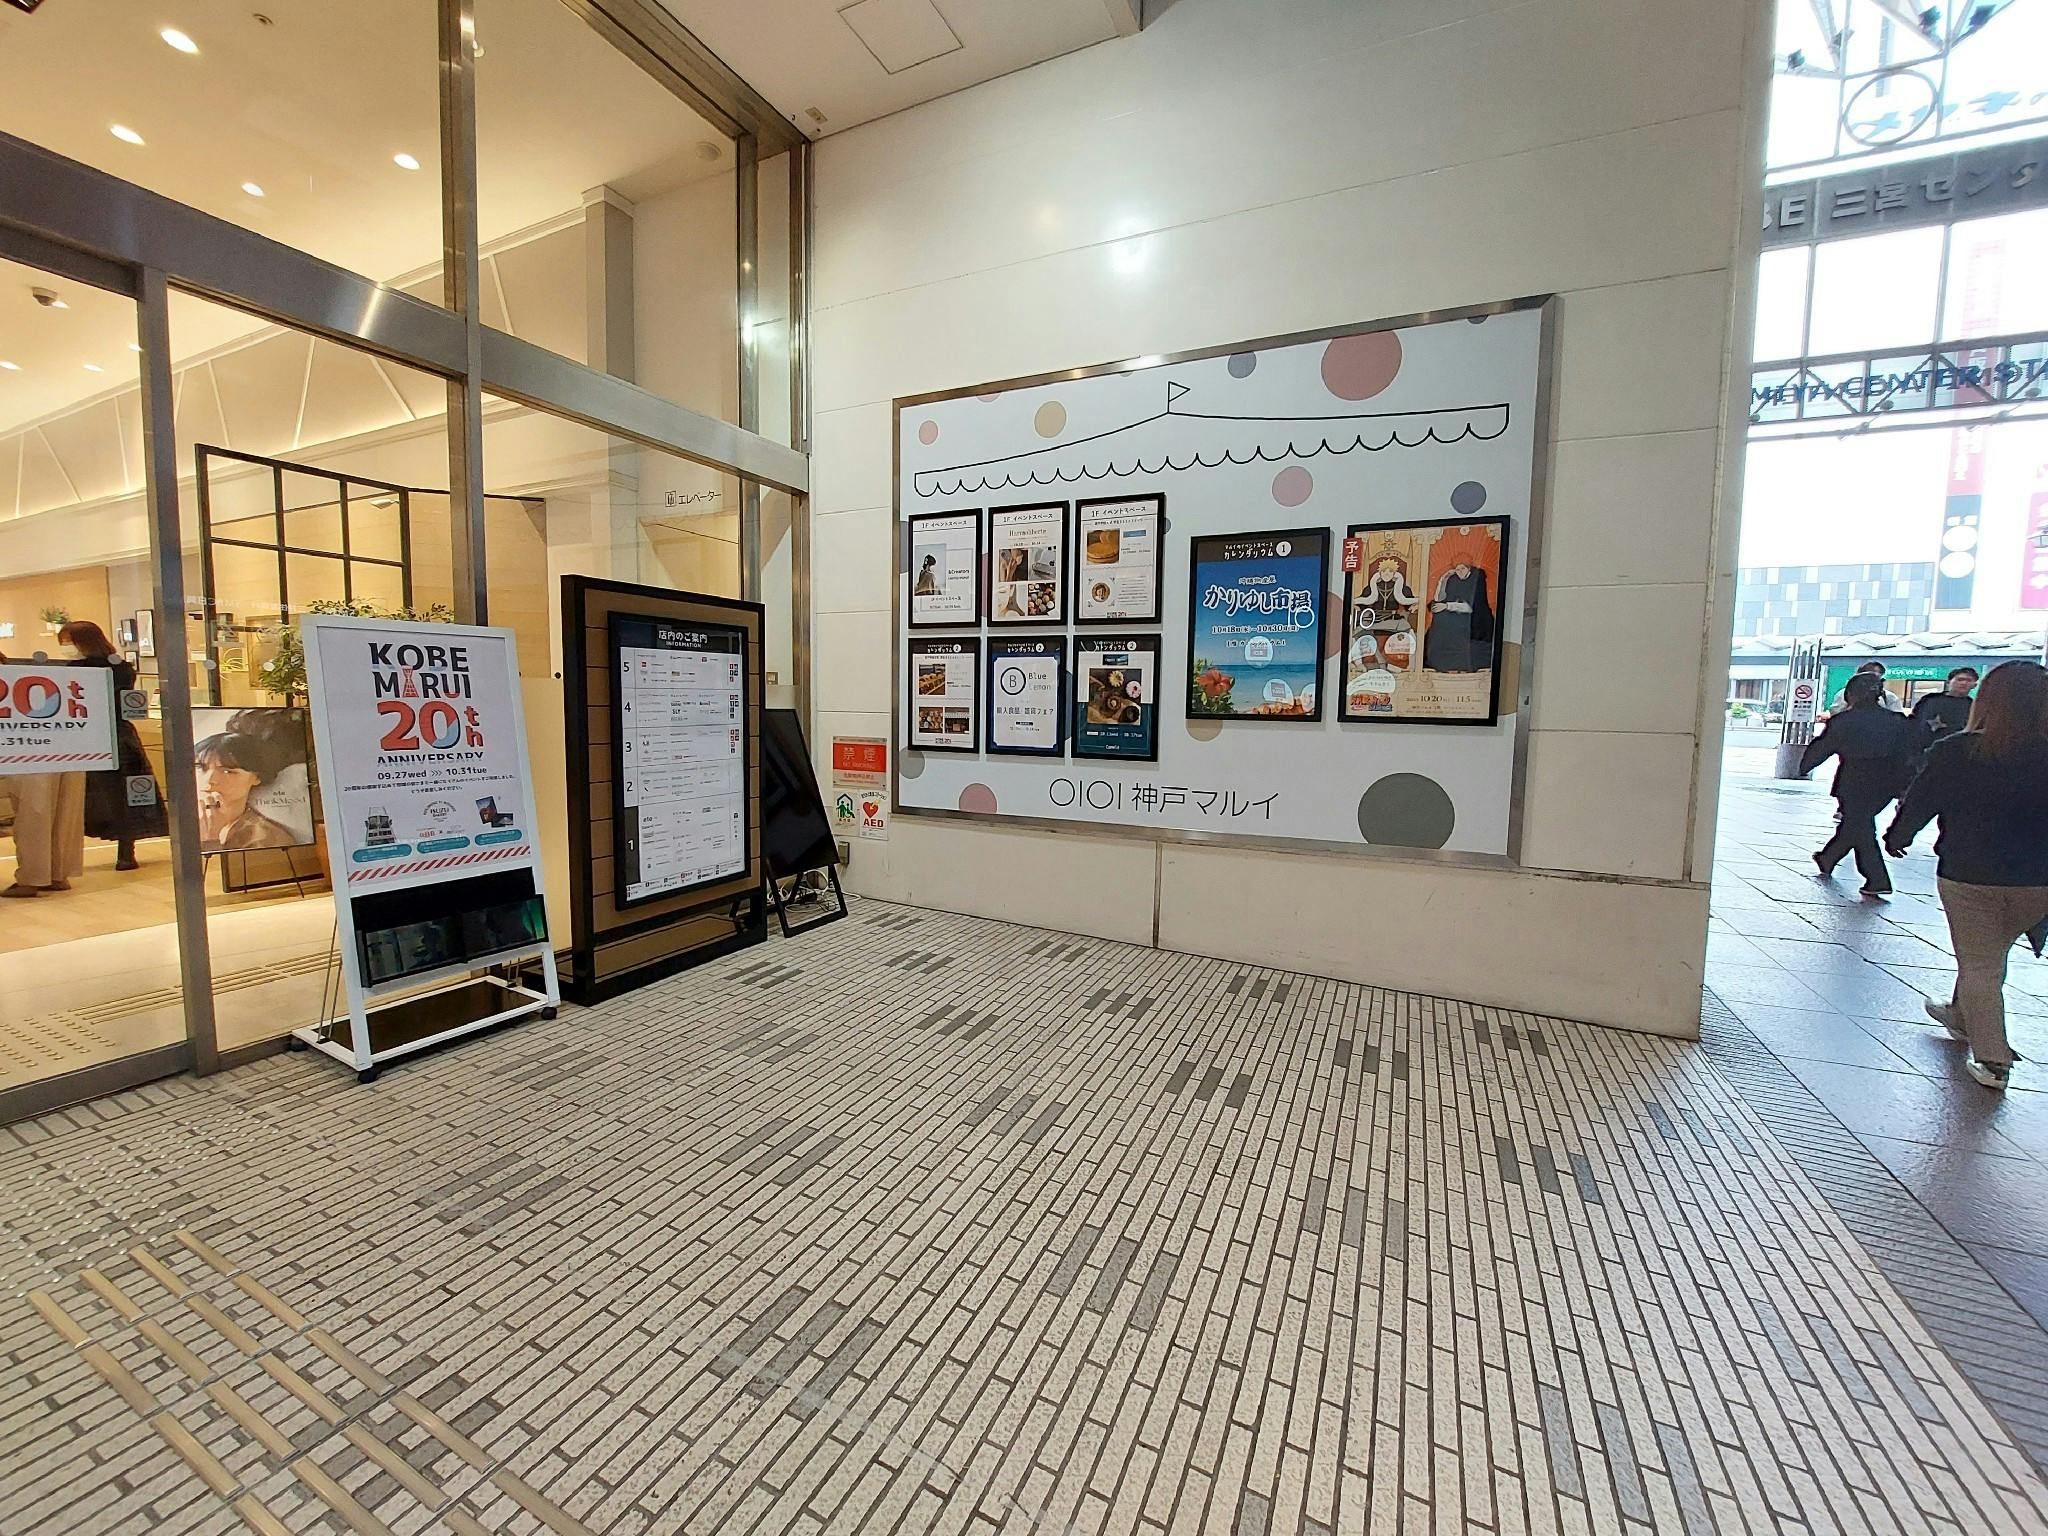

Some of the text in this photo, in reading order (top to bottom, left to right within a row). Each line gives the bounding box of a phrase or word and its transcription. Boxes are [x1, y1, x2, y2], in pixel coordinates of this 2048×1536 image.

[1344, 541, 1359, 569] 予告
[1203, 585, 1312, 617] かりゆし市場
[658, 630, 708, 644] 店内のご案内
[368, 642, 470, 673] KOBE
[623, 662, 630, 672] 5
[372, 670, 472, 699] MARUI
[1009, 672, 1047, 688] B Blue
[624, 701, 632, 712] 4
[625, 742, 632, 752] 3
[377, 752, 484, 766] ANNIVERSARY
[377, 767, 488, 780] 09.27wed 10.31tue
[626, 782, 633, 792] 2
[1131, 783, 1280, 820] 神戸マルイ
[863, 818, 884, 828] AED
[628, 840, 634, 850] 1
